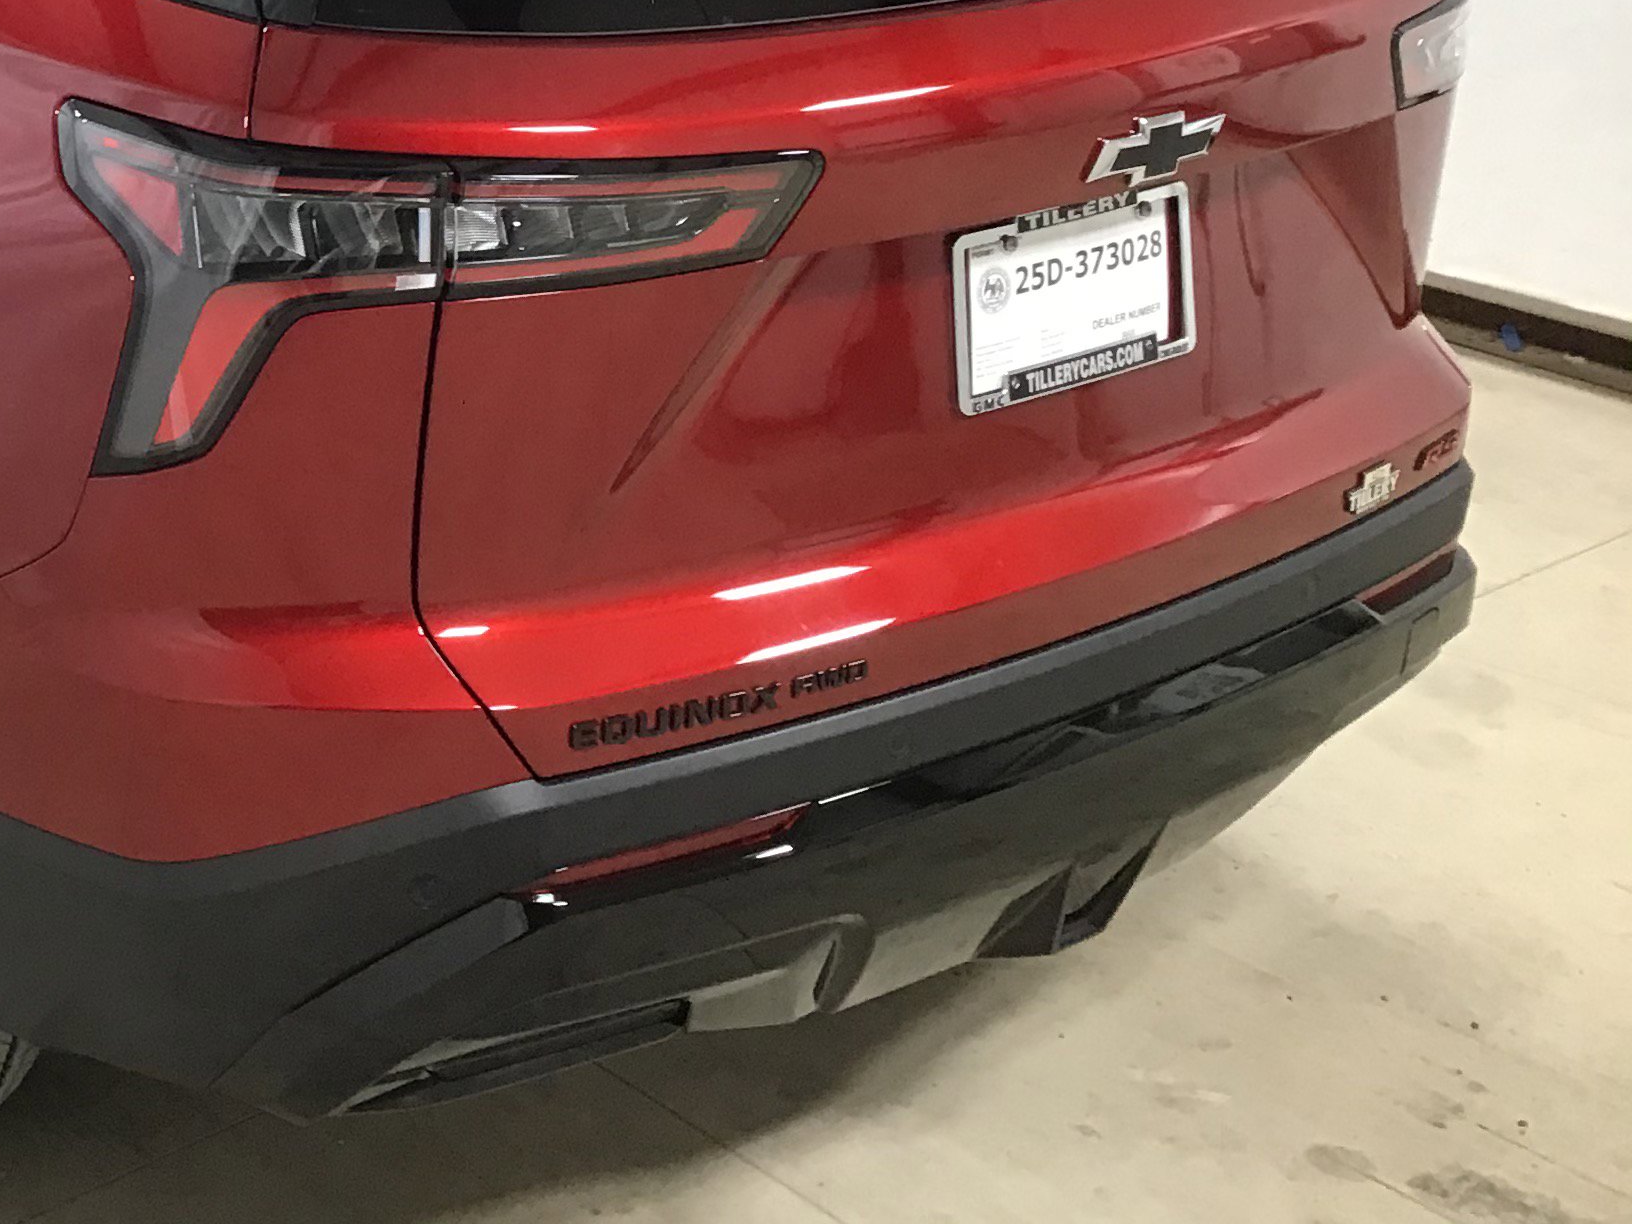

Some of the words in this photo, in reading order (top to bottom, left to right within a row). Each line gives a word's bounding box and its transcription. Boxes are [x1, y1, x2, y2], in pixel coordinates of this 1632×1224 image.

[1022, 190, 1131, 229] TILLERY
[1015, 229, 1163, 295] 25D-373028
[1092, 311, 1127, 331] DEALER
[1128, 301, 1162, 322] NUMBER
[1025, 341, 1145, 394] TILLERYCARS.COM
[568, 679, 783, 752] EQUINOX
[789, 658, 868, 700] AWD
